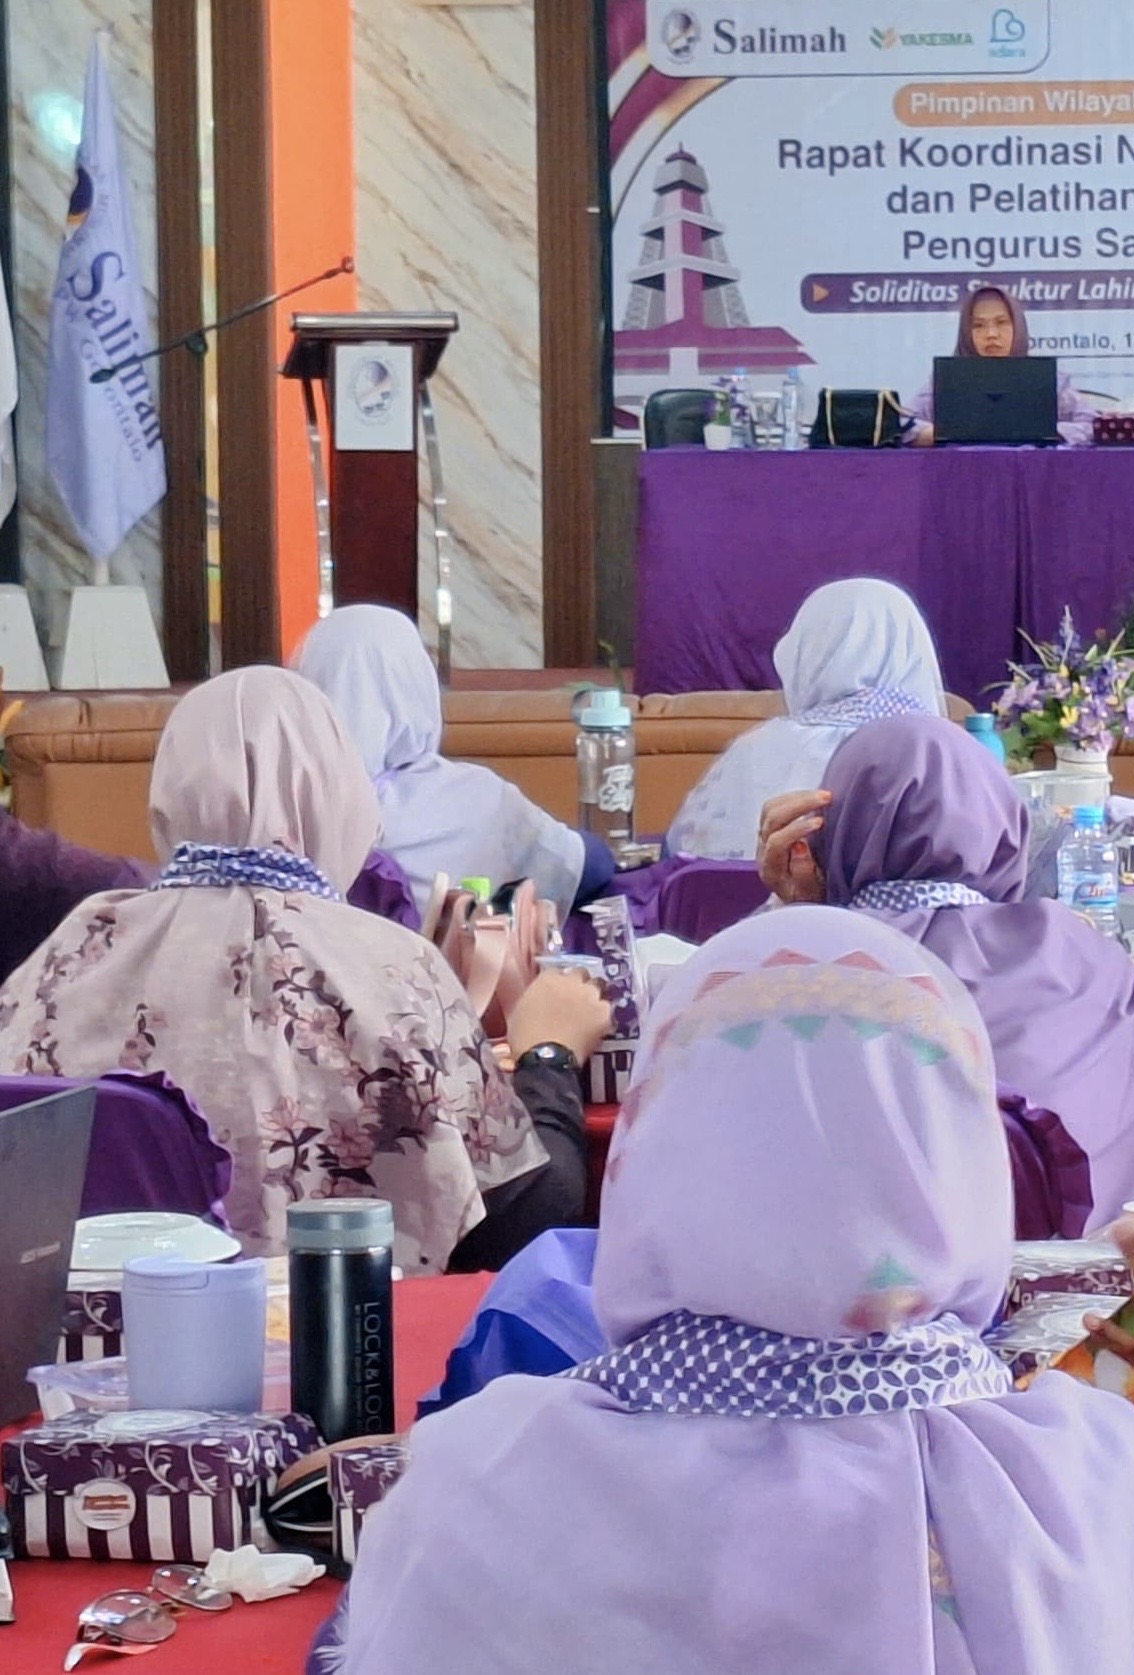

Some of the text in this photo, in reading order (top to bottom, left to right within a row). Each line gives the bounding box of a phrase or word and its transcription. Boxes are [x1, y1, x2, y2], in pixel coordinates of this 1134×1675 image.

[713, 19, 846, 54] Salimah
[911, 91, 1035, 119] Pimpinan
[778, 138, 886, 176] Rapat
[899, 135, 1102, 168] Koordinasi
[886, 184, 955, 215] dan
[902, 230, 1082, 268] Pengurus
[850, 280, 959, 304] Soliditas
[966, 277, 1072, 302] Suktur
[1027, 332, 1116, 351] orontalo,
